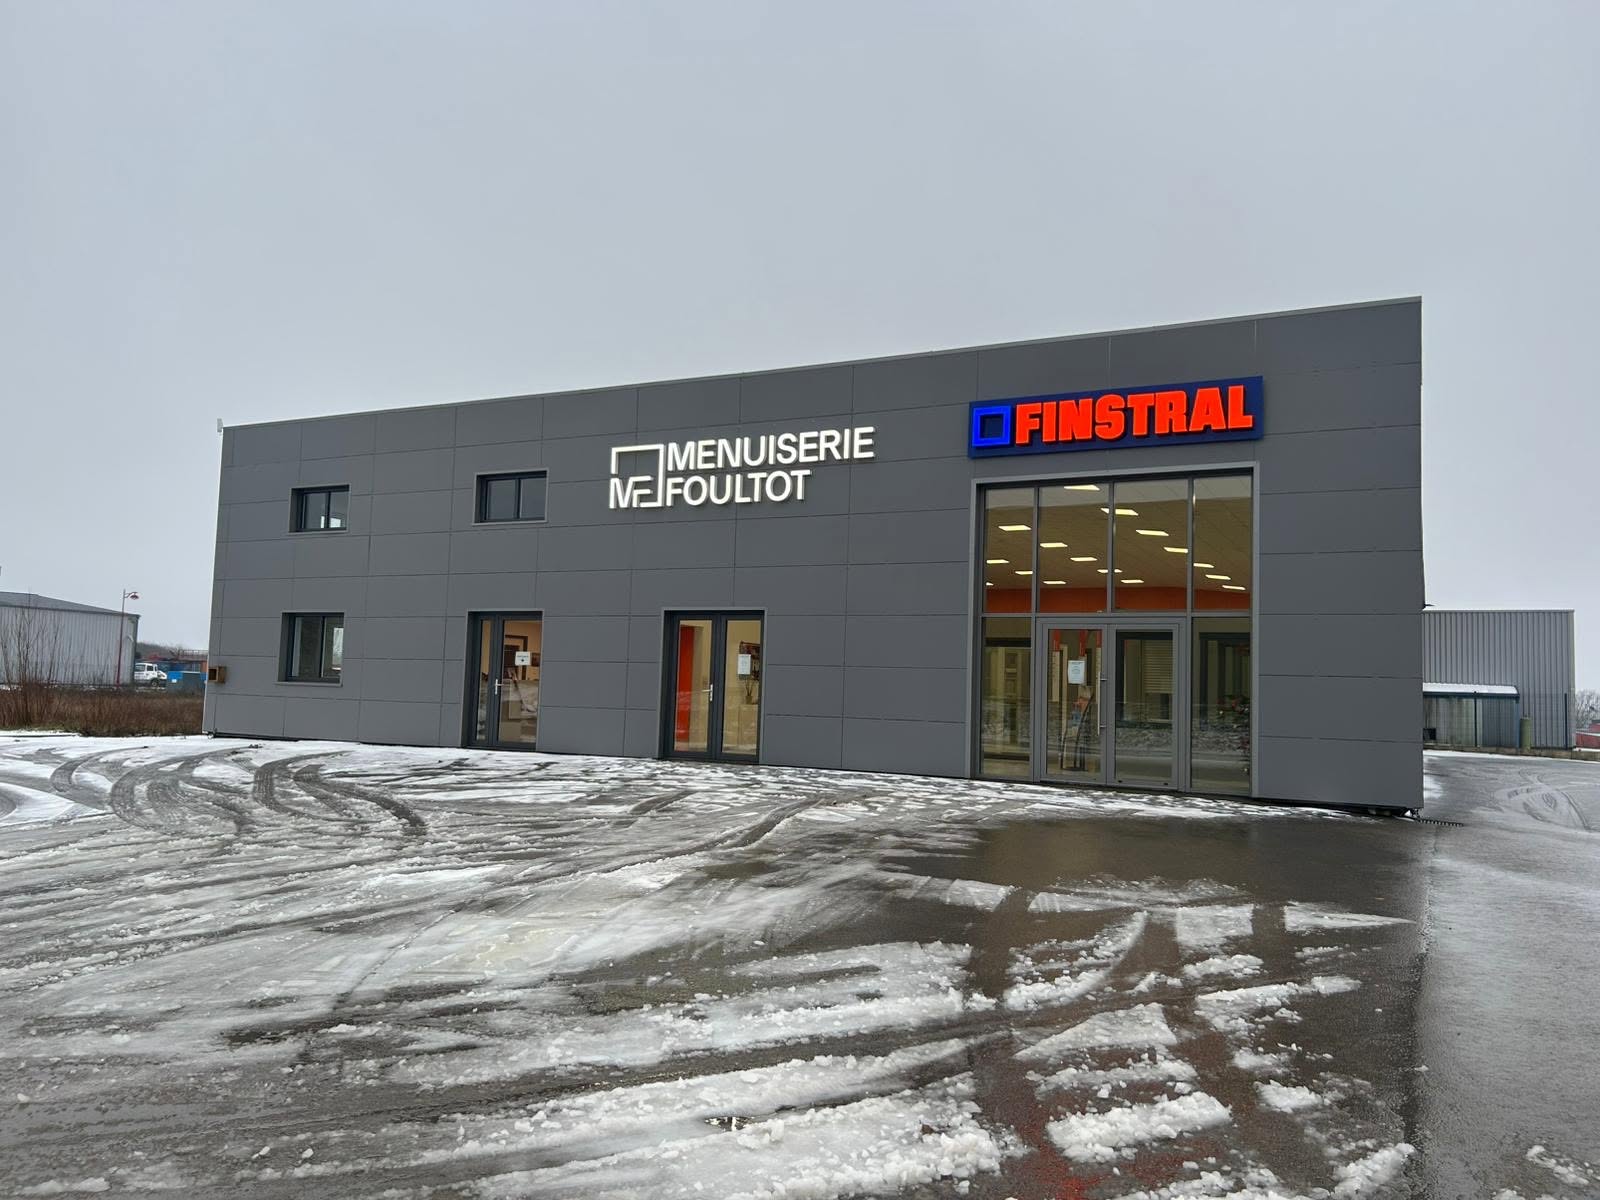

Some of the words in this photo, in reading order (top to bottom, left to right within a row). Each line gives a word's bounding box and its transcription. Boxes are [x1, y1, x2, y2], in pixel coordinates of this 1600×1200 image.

[1015, 384, 1254, 445] FINSTRAL
[667, 426, 875, 471] MENUISERIE
[665, 469, 811, 507] FOULTOT
